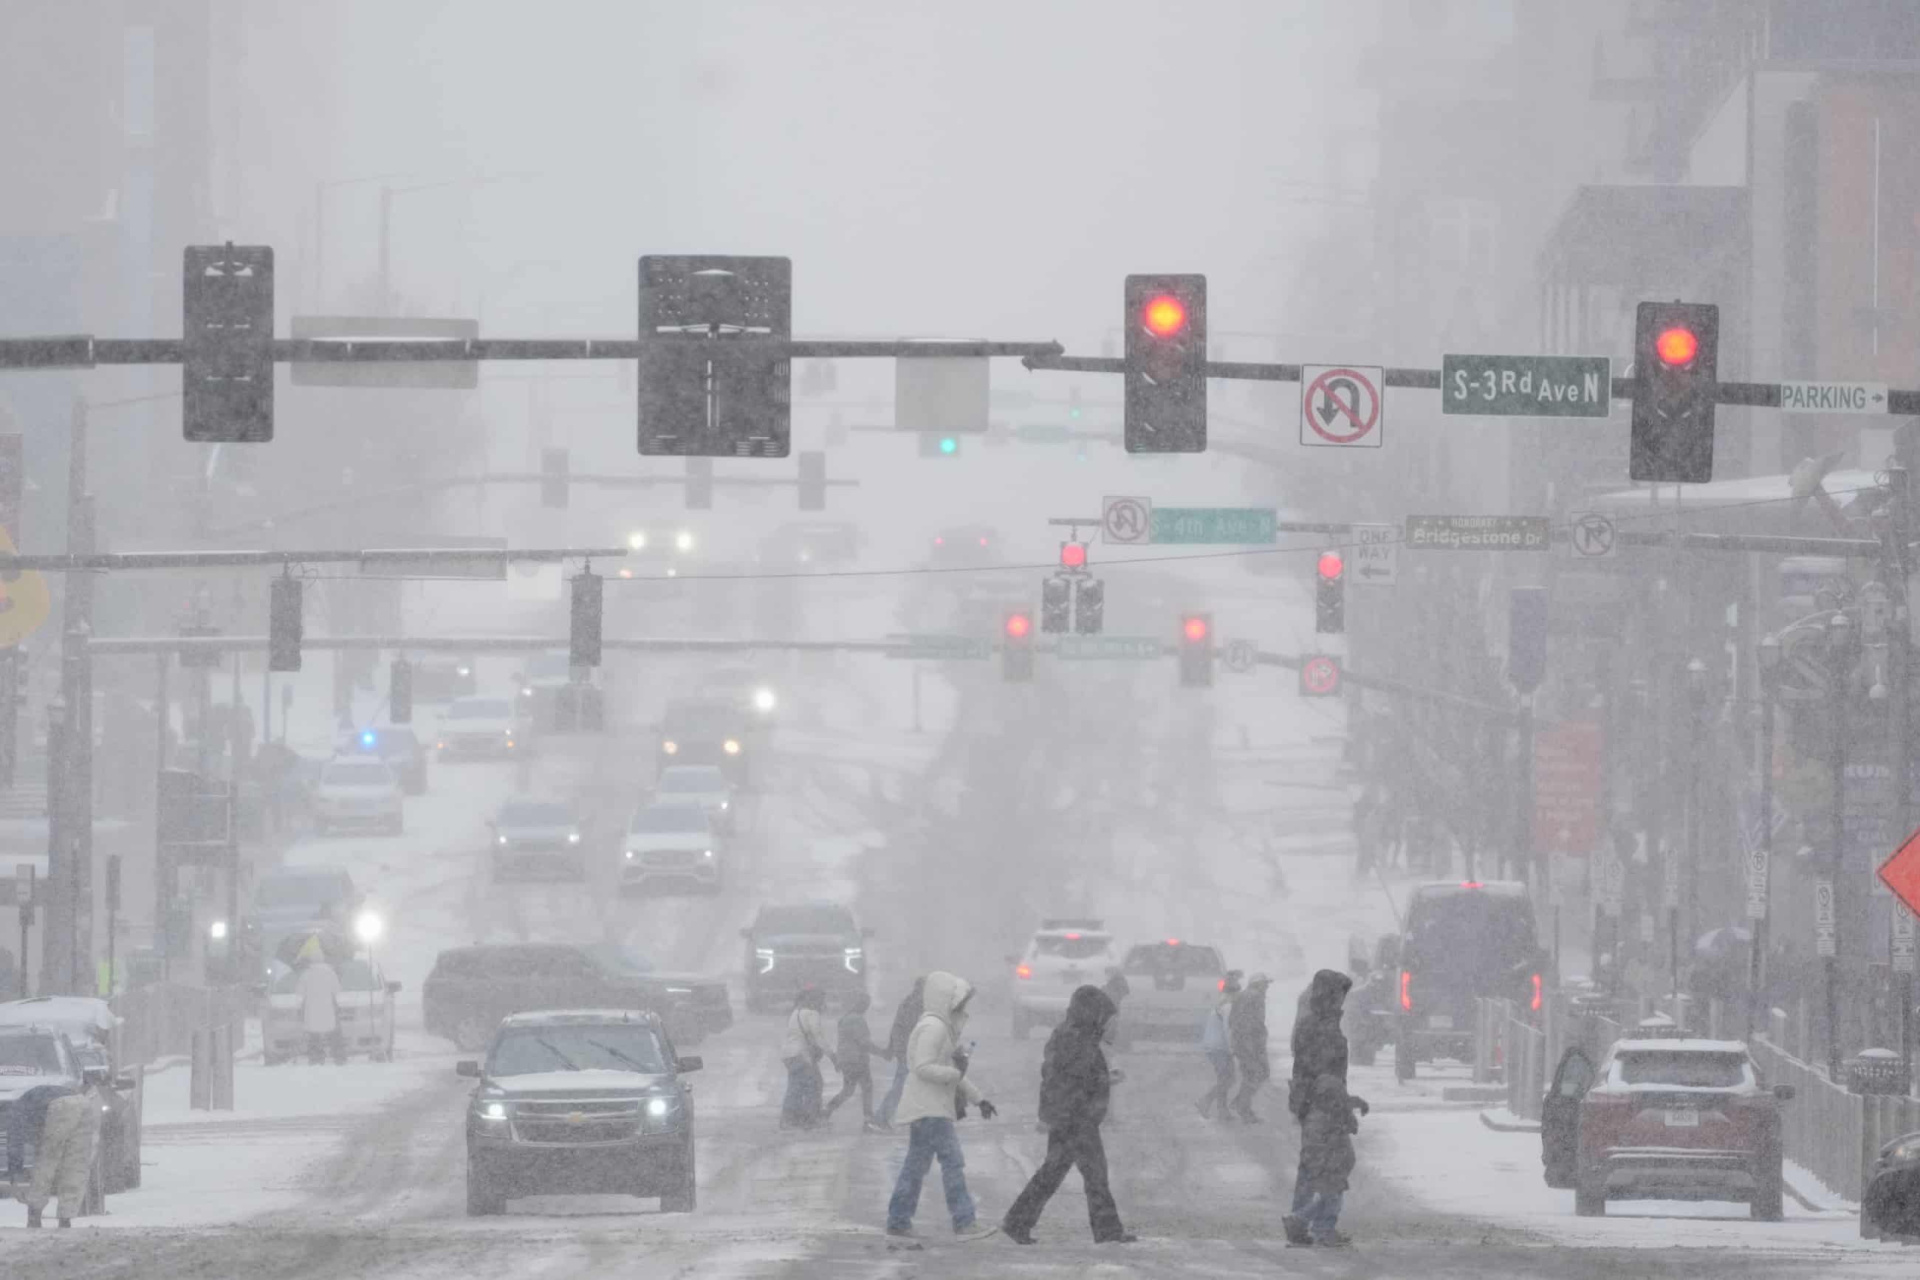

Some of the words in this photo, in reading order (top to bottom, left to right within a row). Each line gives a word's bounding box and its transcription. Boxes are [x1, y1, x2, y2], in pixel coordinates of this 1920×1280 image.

[1537, 378, 1579, 402] Ave
[1583, 372, 1599, 403] N
[1782, 385, 1866, 409] PARKING
[1359, 529, 1391, 544] ONE
[1414, 528, 1521, 547] Bridgestone
[1525, 532, 1543, 545] Dr
[1359, 546, 1389, 561] WAY
